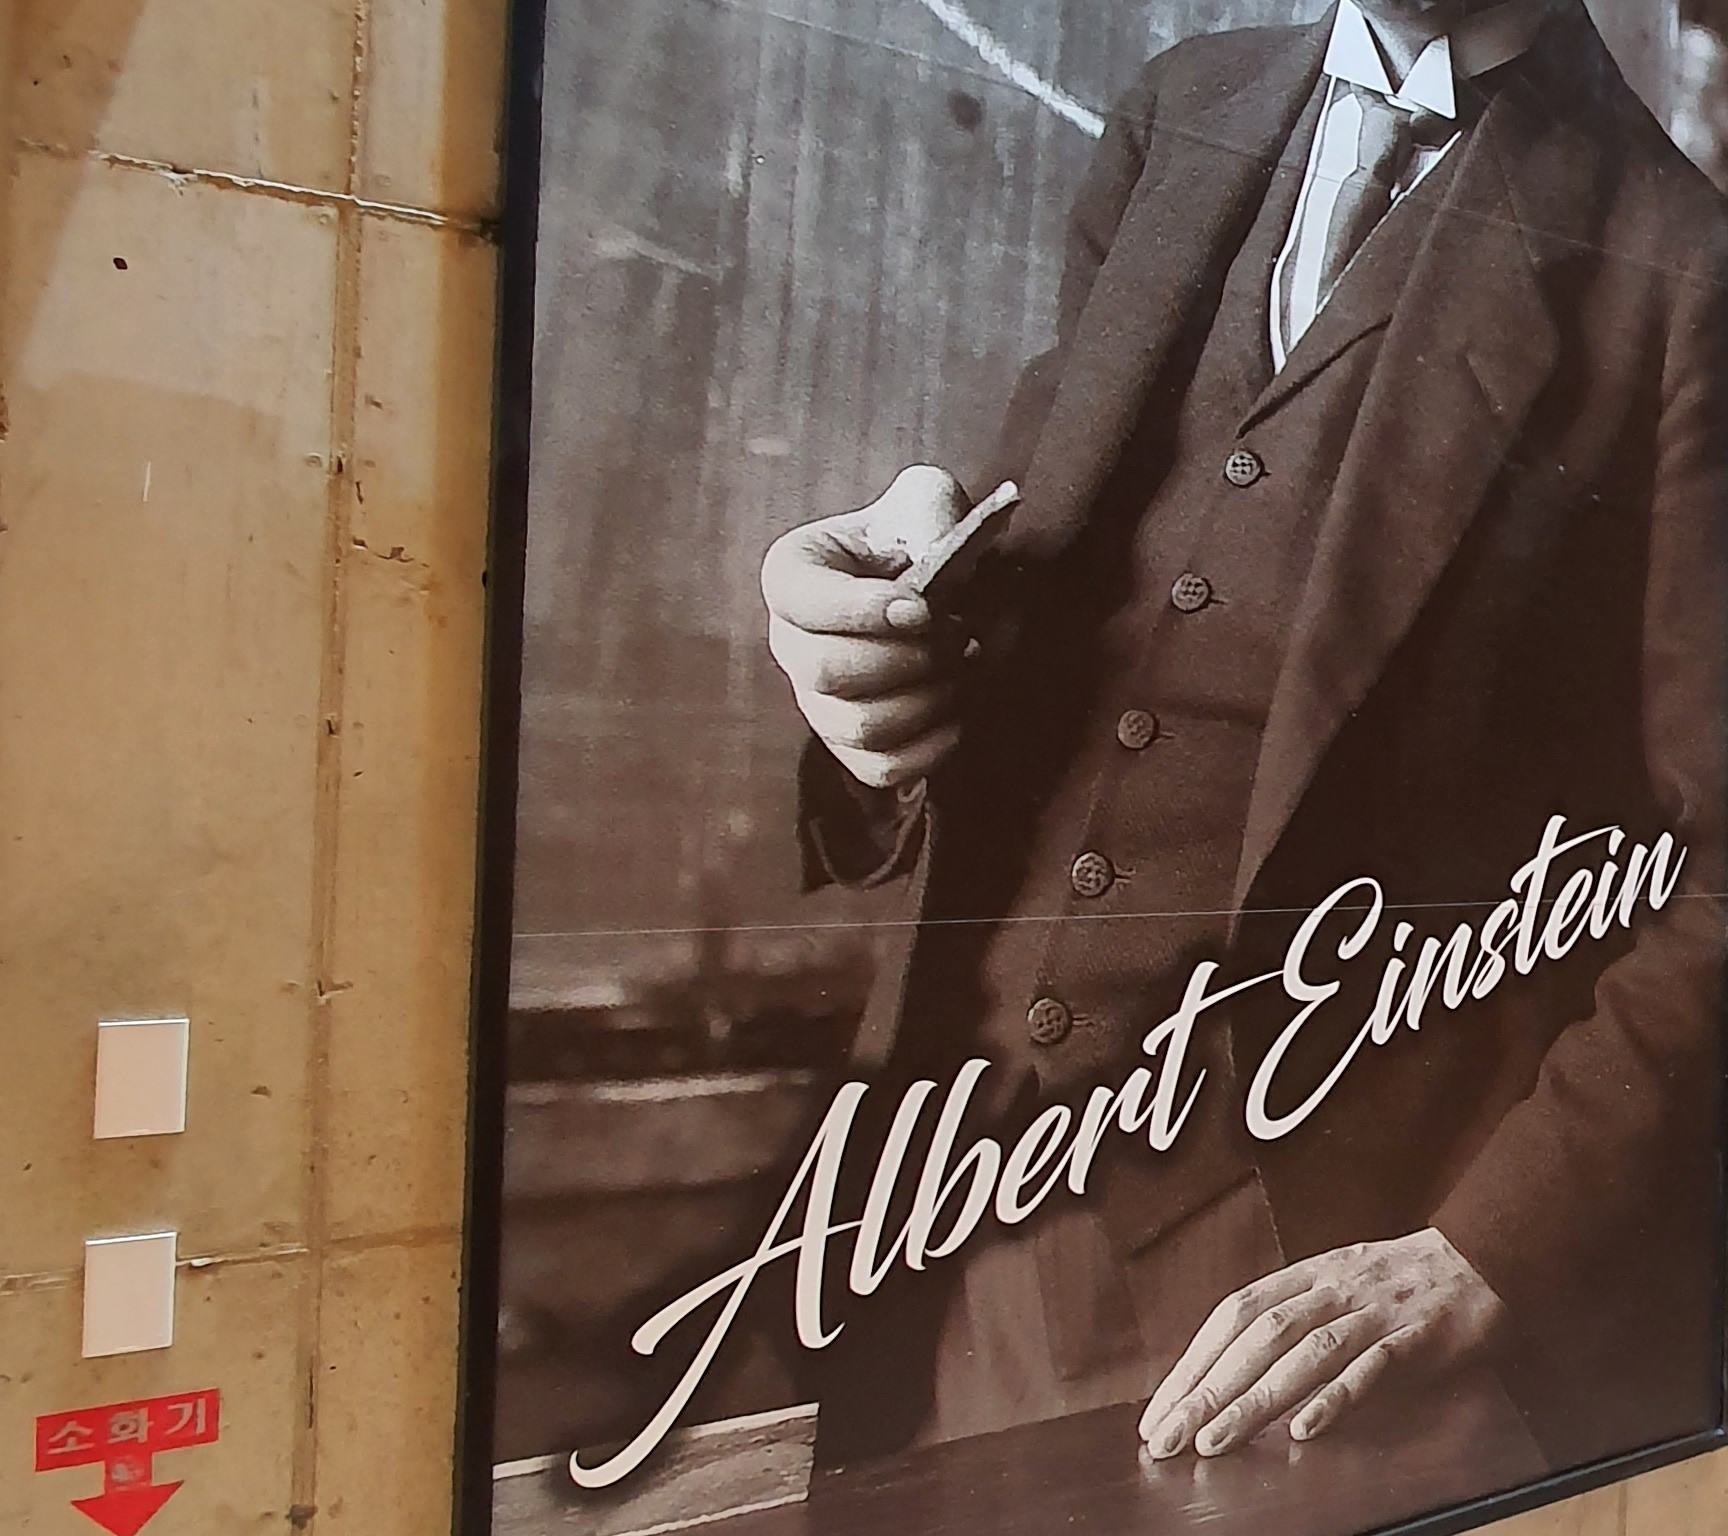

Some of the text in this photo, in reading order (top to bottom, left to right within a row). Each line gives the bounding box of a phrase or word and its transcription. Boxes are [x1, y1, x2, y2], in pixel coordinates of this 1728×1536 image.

[569, 814, 1688, 1489] Albert Einstein
[48, 1397, 206, 1454] 소화기
